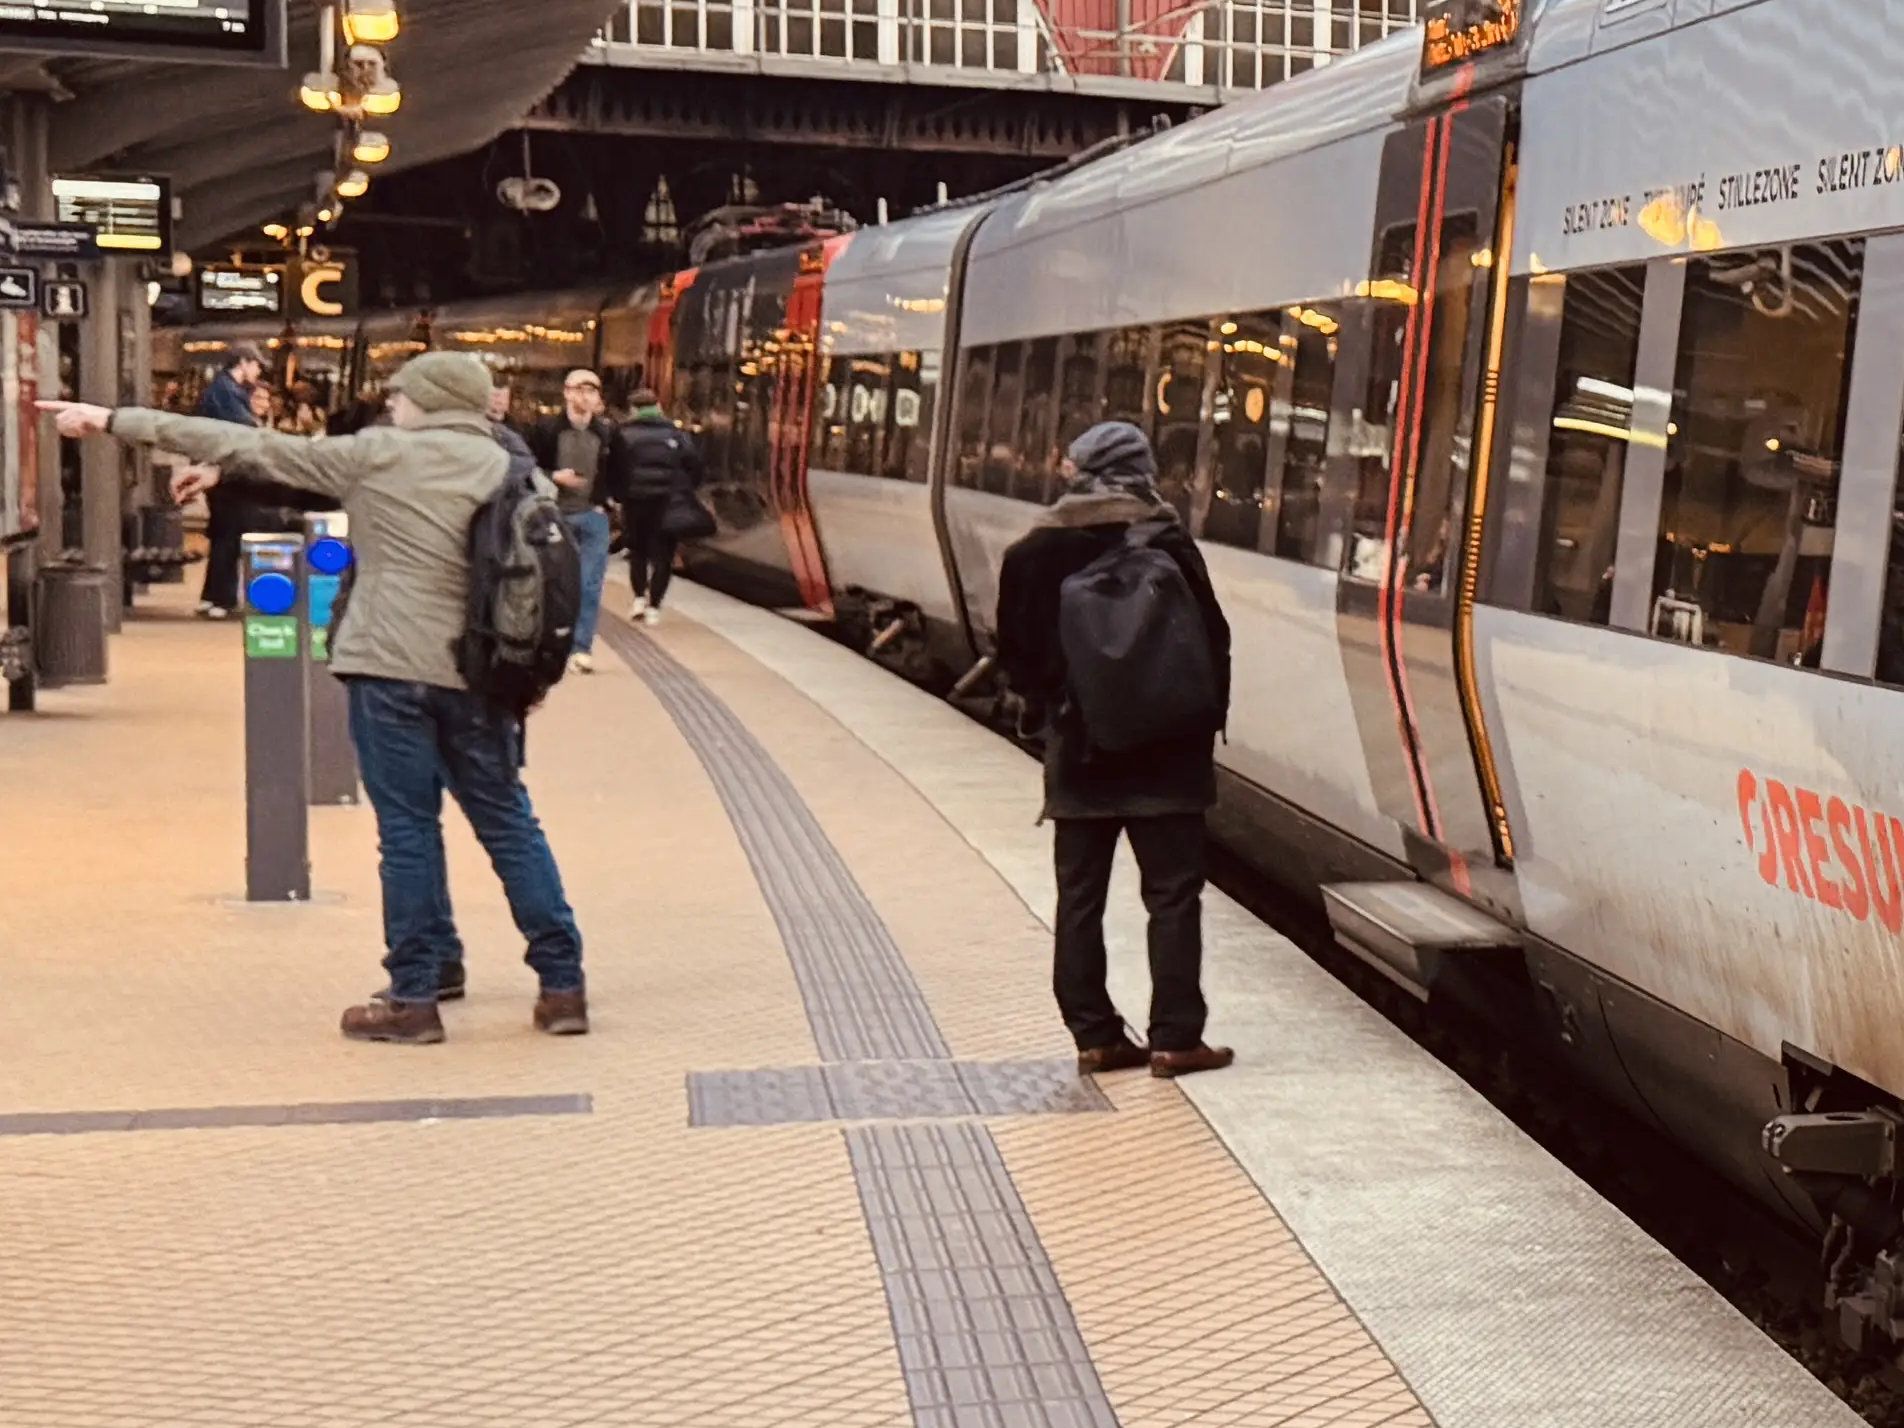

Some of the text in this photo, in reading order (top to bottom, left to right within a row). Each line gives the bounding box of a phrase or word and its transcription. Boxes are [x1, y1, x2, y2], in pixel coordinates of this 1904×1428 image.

[1718, 164, 1800, 210] STILLEZONE
[1816, 151, 1870, 194] SILENT
[301, 269, 344, 316] C
